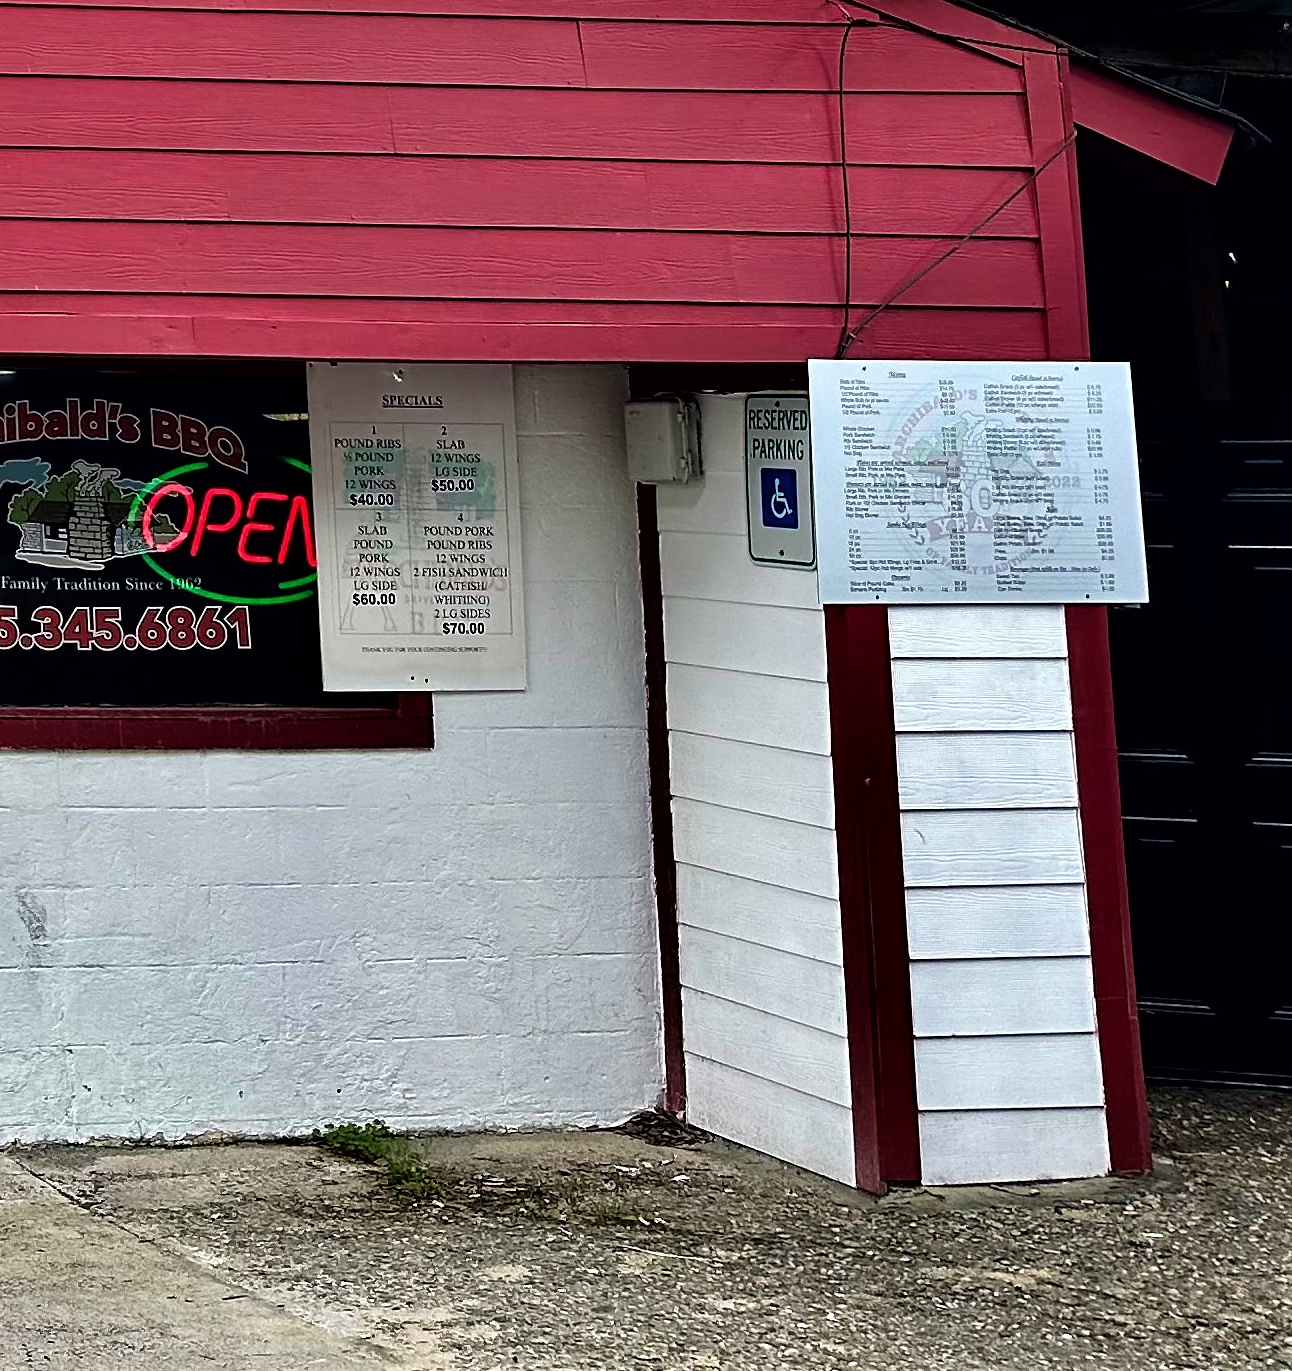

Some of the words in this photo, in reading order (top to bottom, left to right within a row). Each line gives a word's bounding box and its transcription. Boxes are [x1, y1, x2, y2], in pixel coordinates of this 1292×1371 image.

[382, 395, 444, 406] SPECIALS
[748, 409, 808, 430] RESERVED
[441, 426, 447, 435] 2
[150, 408, 248, 474] BBQ
[334, 439, 373, 448] POUND
[377, 439, 401, 448] RIBS
[436, 440, 465, 449] SLAB
[752, 438, 804, 460] PARKING
[355, 453, 394, 462] POUND
[431, 454, 441, 462] 12
[444, 454, 481, 463] WINGS
[355, 466, 384, 475] PORK
[435, 467, 449, 476] LG
[453, 467, 477, 476] SIDE
[346, 480, 356, 489] 12
[360, 480, 396, 489] WINGS
[431, 479, 474, 492] $50.00
[350, 494, 393, 506] $40.00
[376, 512, 381, 521] 3
[458, 513, 463, 522] 4
[143, 483, 318, 567] OPEN
[358, 526, 387, 535] SLAB
[424, 526, 462, 536] POUND
[465, 526, 494, 536] PORK
[354, 540, 393, 549] POUND
[427, 540, 465, 549] POUND
[468, 540, 492, 549] RIBS
[359, 554, 388, 562] PORK
[436, 554, 446, 563] 12
[450, 554, 485, 563] WINGS
[350, 567, 360, 576] 12
[364, 567, 400, 576] WINGS
[413, 568, 419, 576] 2
[422, 568, 445, 577] FISH
[449, 568, 507, 577] SANDWICH
[1, 576, 48, 592] Family
[52, 577, 120, 591] Tradition
[125, 577, 164, 591] Since
[354, 581, 368, 590] LG
[372, 581, 397, 590] SIDE
[352, 593, 395, 606] $60.00
[434, 609, 439, 618] 2
[443, 609, 457, 618] LG
[460, 609, 490, 618] SIDES
[443, 622, 484, 634] $70.00
